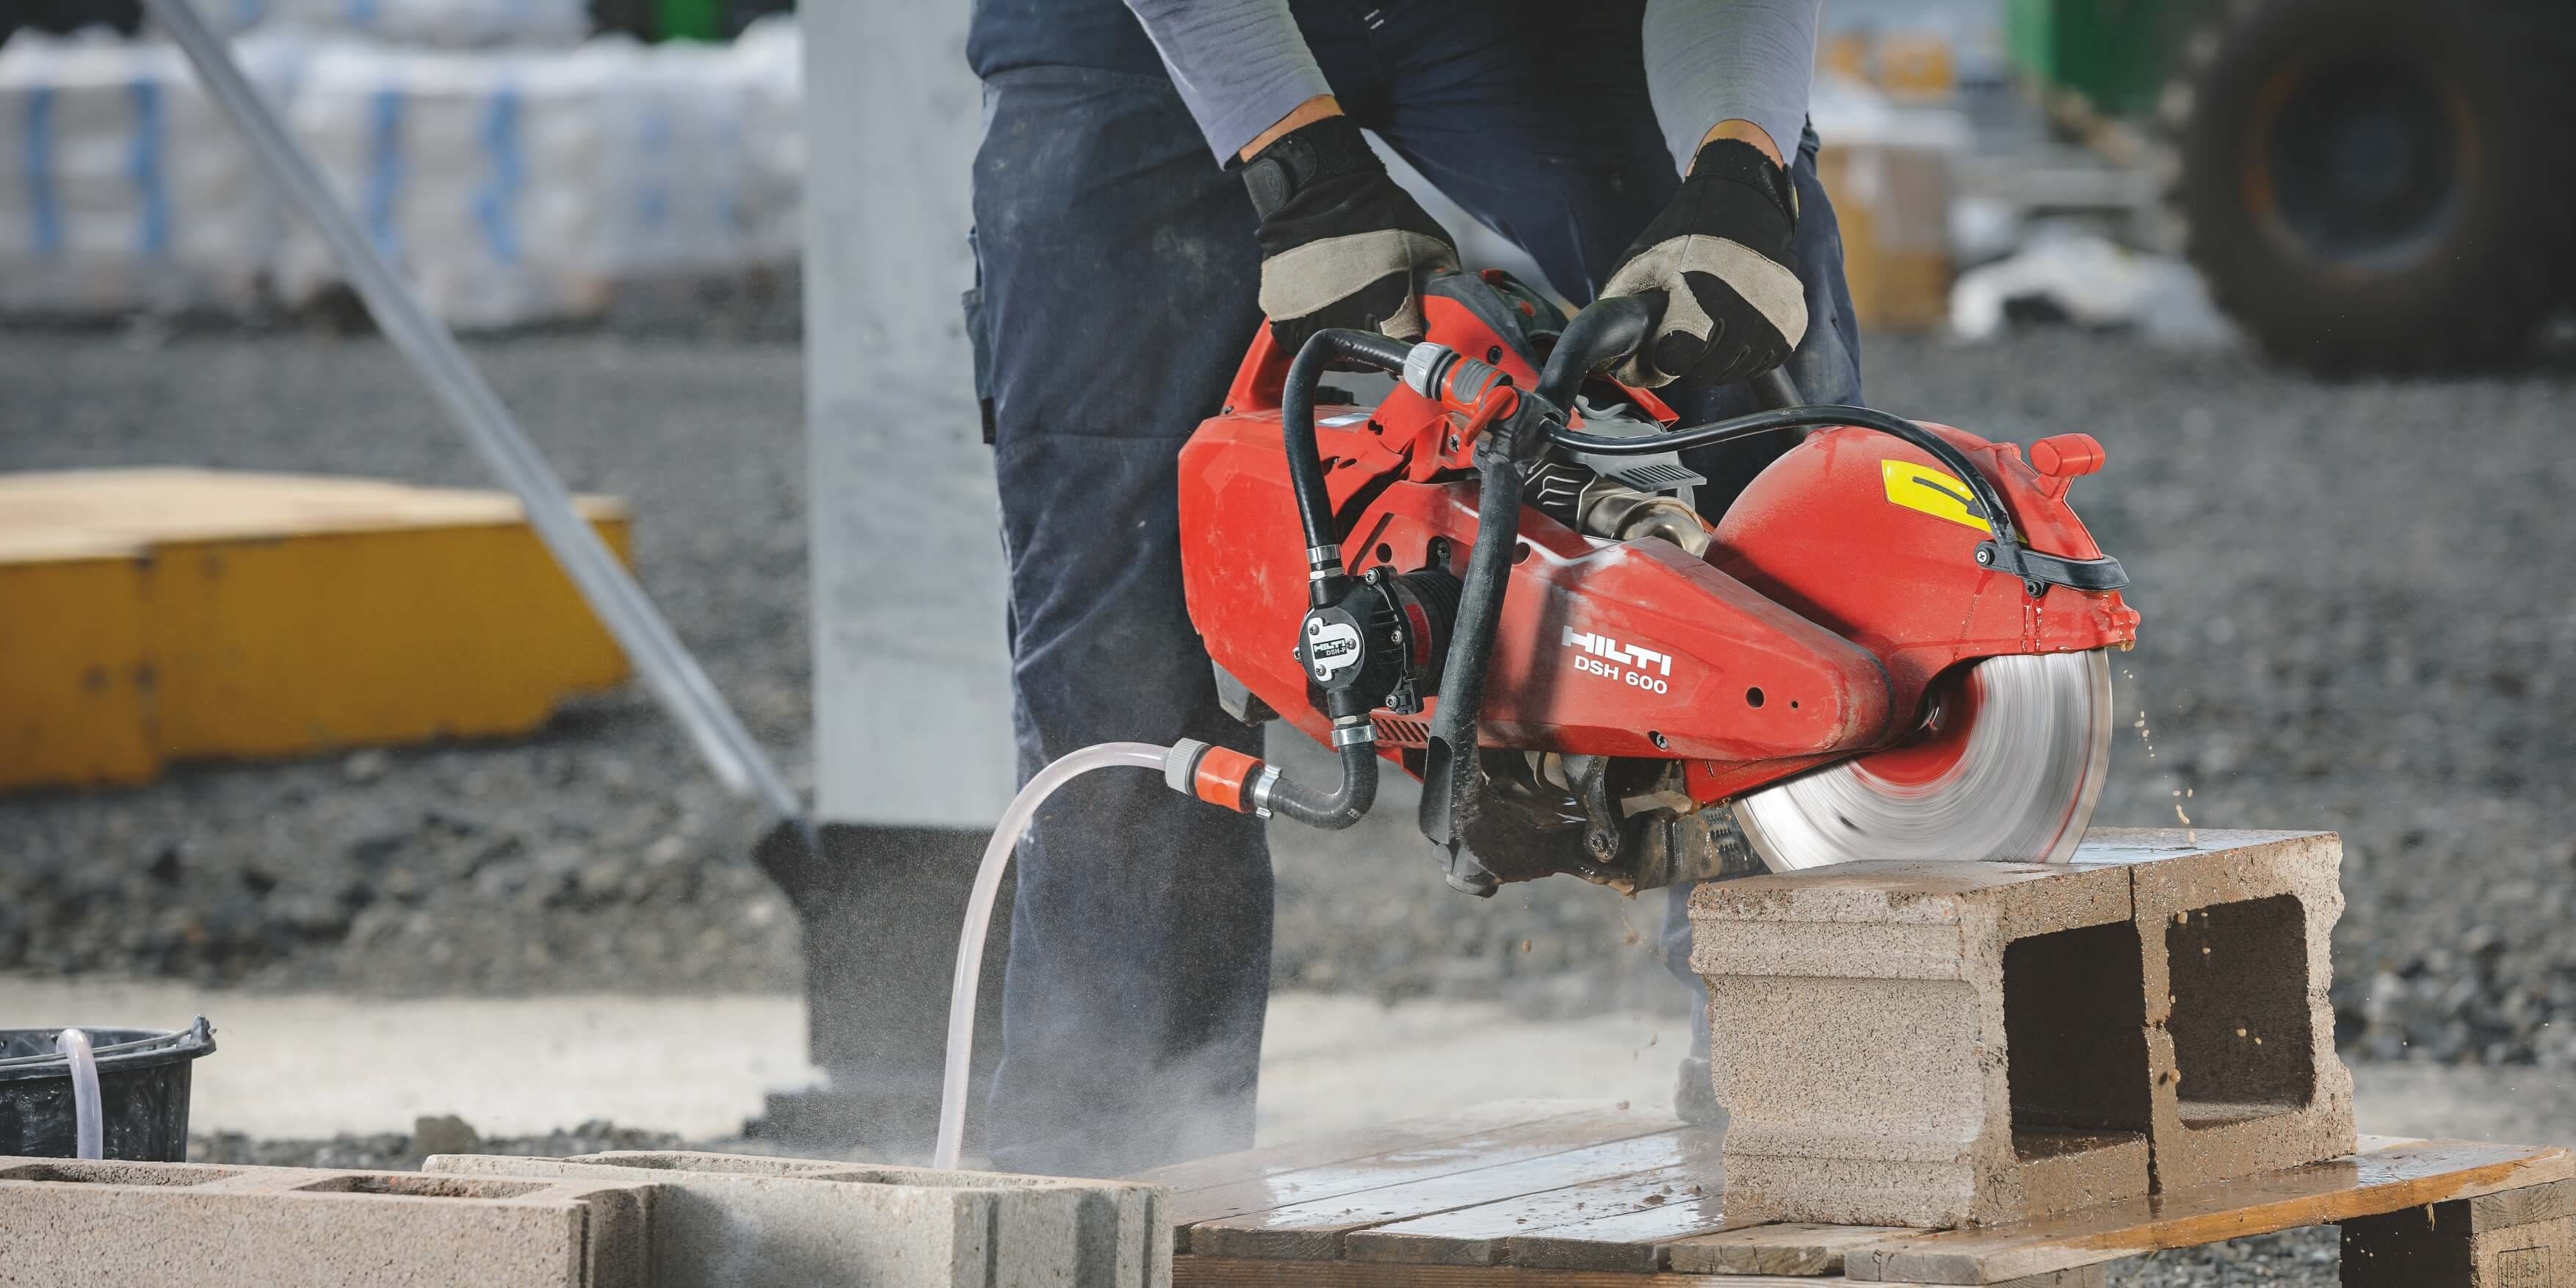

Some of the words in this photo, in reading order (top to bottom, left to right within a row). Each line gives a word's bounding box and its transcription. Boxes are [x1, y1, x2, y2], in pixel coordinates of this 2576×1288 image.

[1314, 640, 1345, 653] HILTI
[1326, 647, 1346, 656] DSH-P
[1562, 625, 1672, 676] HILTI
[1574, 654, 1619, 681] DSH
[1625, 671, 1668, 695] 600
